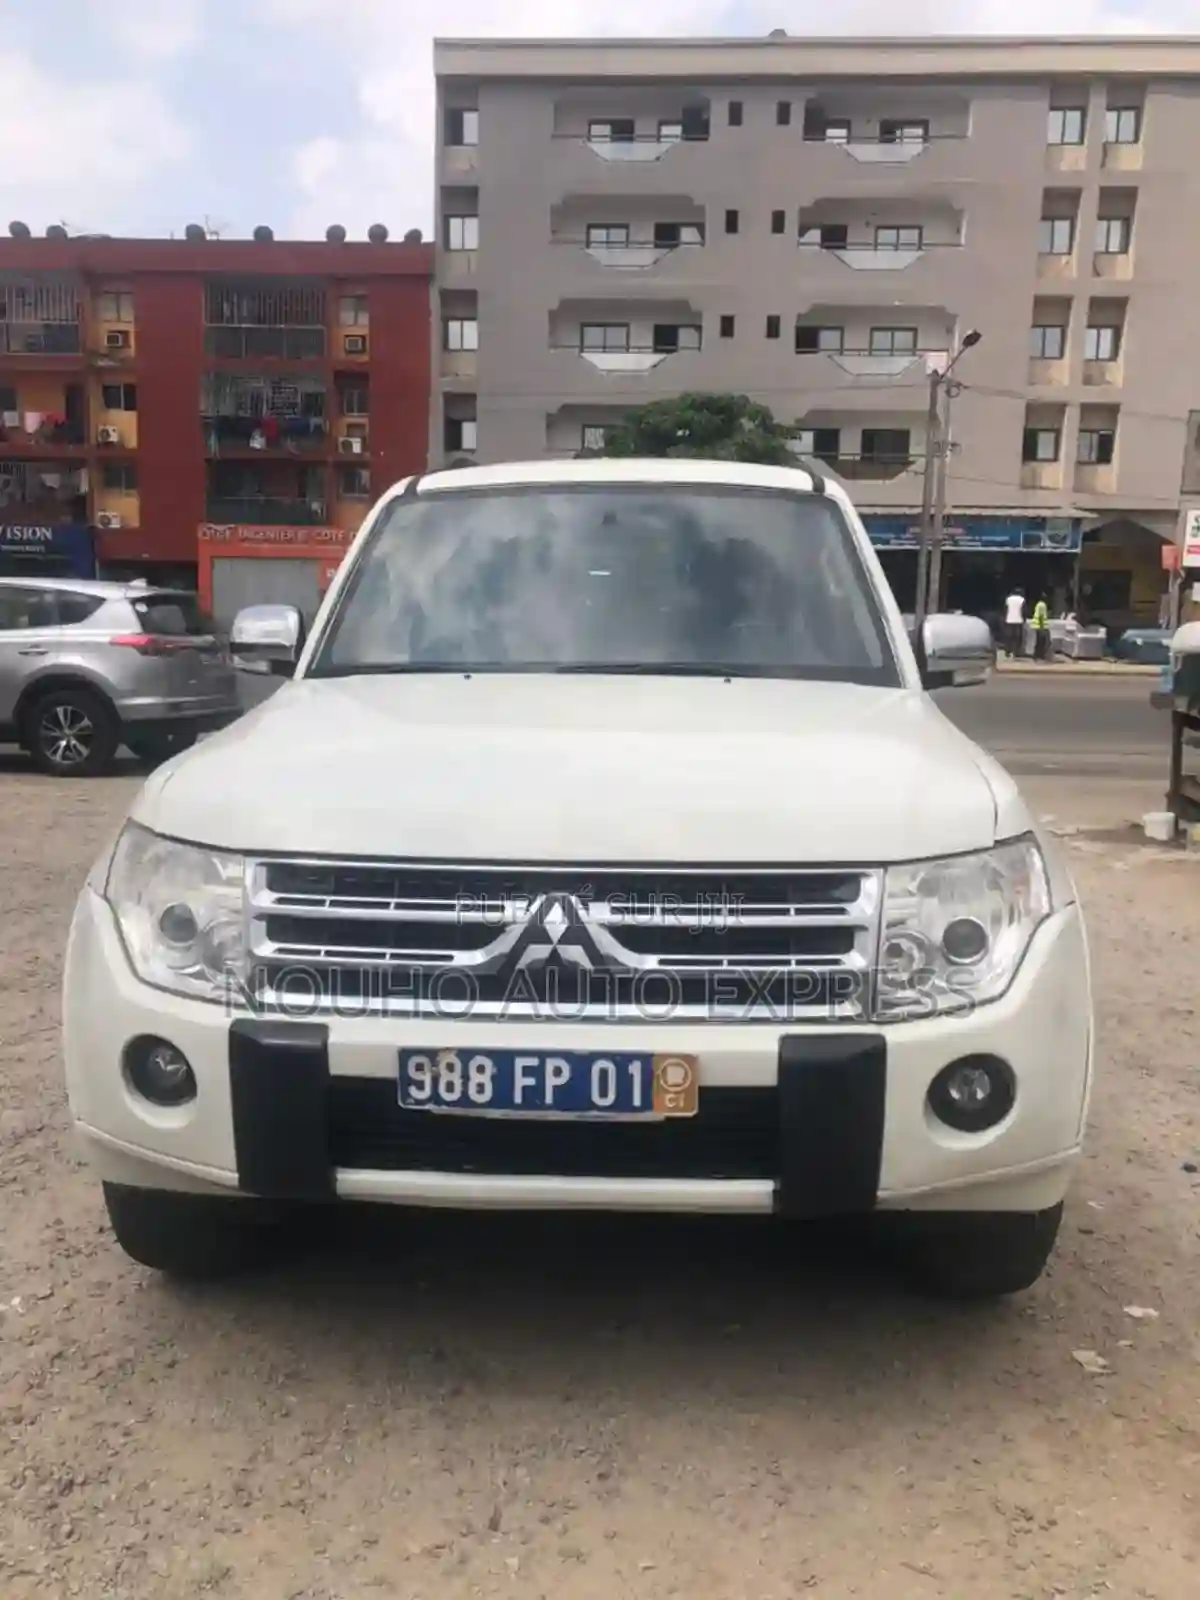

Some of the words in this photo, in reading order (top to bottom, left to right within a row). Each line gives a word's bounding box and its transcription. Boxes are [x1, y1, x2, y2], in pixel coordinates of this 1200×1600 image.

[407, 1054, 495, 1104] 988
[513, 1056, 572, 1105] FP
[590, 1058, 643, 1108] 01
